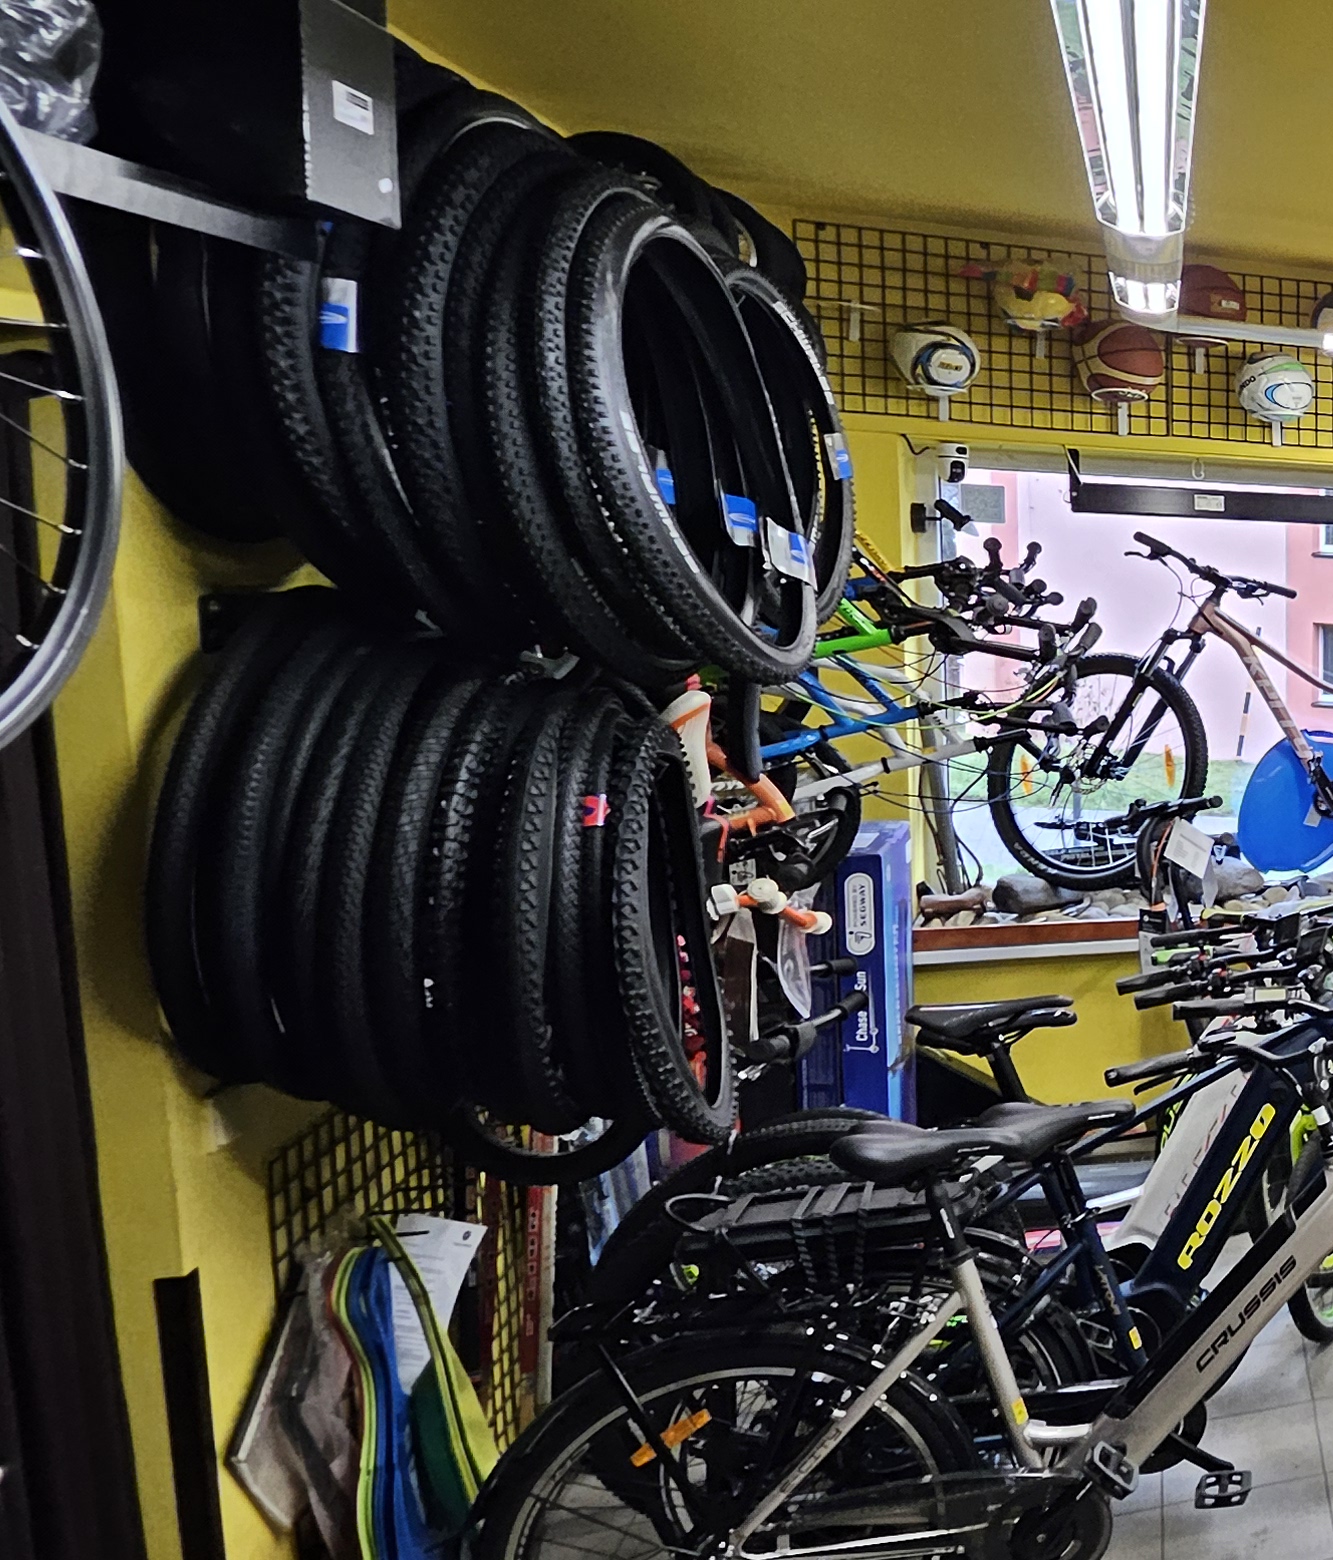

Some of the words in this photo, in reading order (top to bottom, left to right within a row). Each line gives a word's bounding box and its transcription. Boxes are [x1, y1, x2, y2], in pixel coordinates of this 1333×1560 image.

[857, 884, 867, 927] SEGWAY
[853, 971, 867, 991] Sun
[855, 1010, 869, 1042] Chase
[1177, 1102, 1277, 1271] ROZZO
[1194, 1253, 1300, 1375] CRUSSIS
